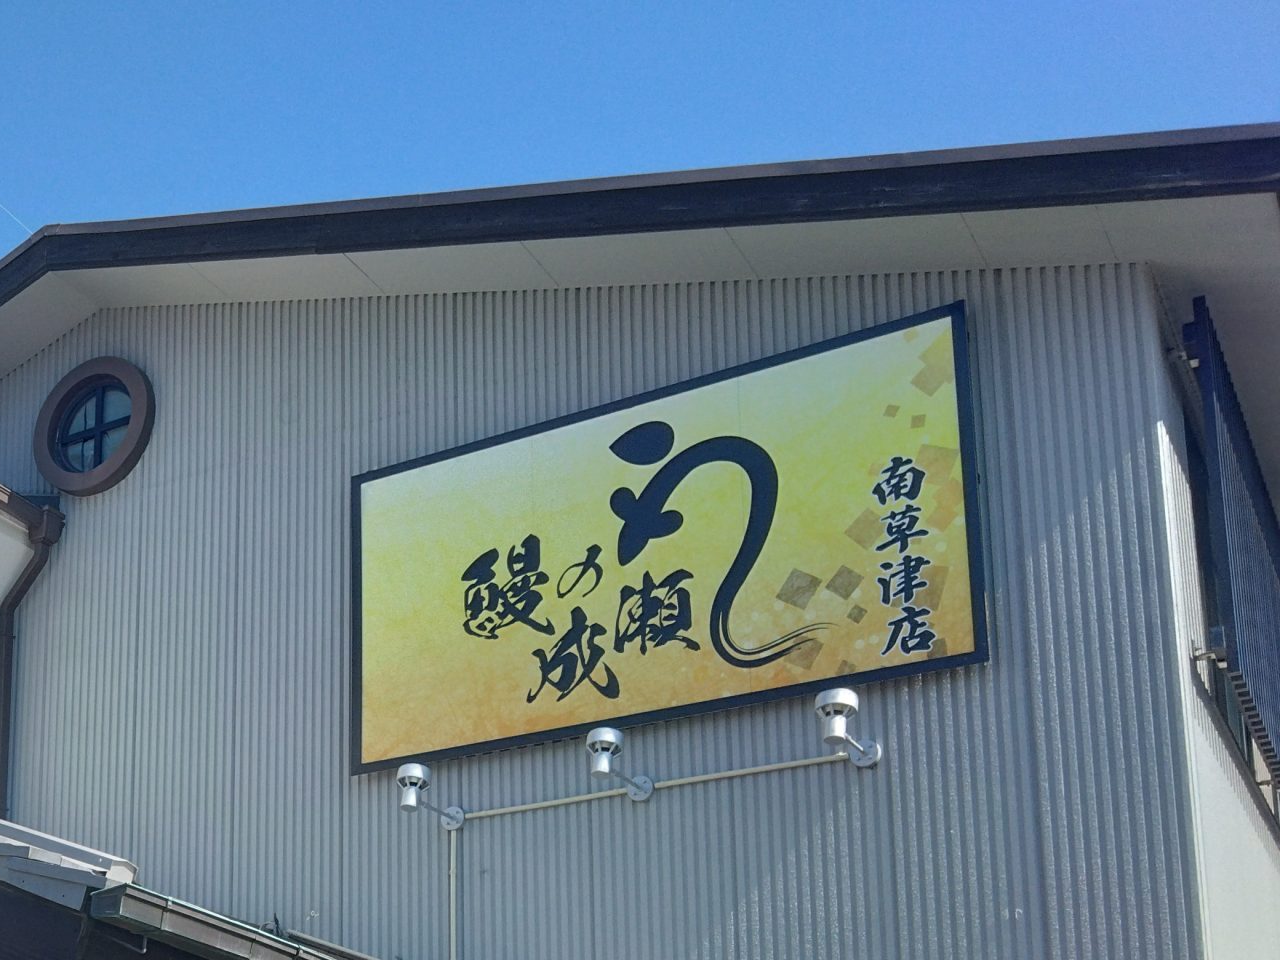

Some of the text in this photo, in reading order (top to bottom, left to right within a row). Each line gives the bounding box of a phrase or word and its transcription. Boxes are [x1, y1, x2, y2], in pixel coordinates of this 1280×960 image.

[461, 534, 701, 703] 鰻の成瀬
[872, 456, 936, 656] 南草津店
